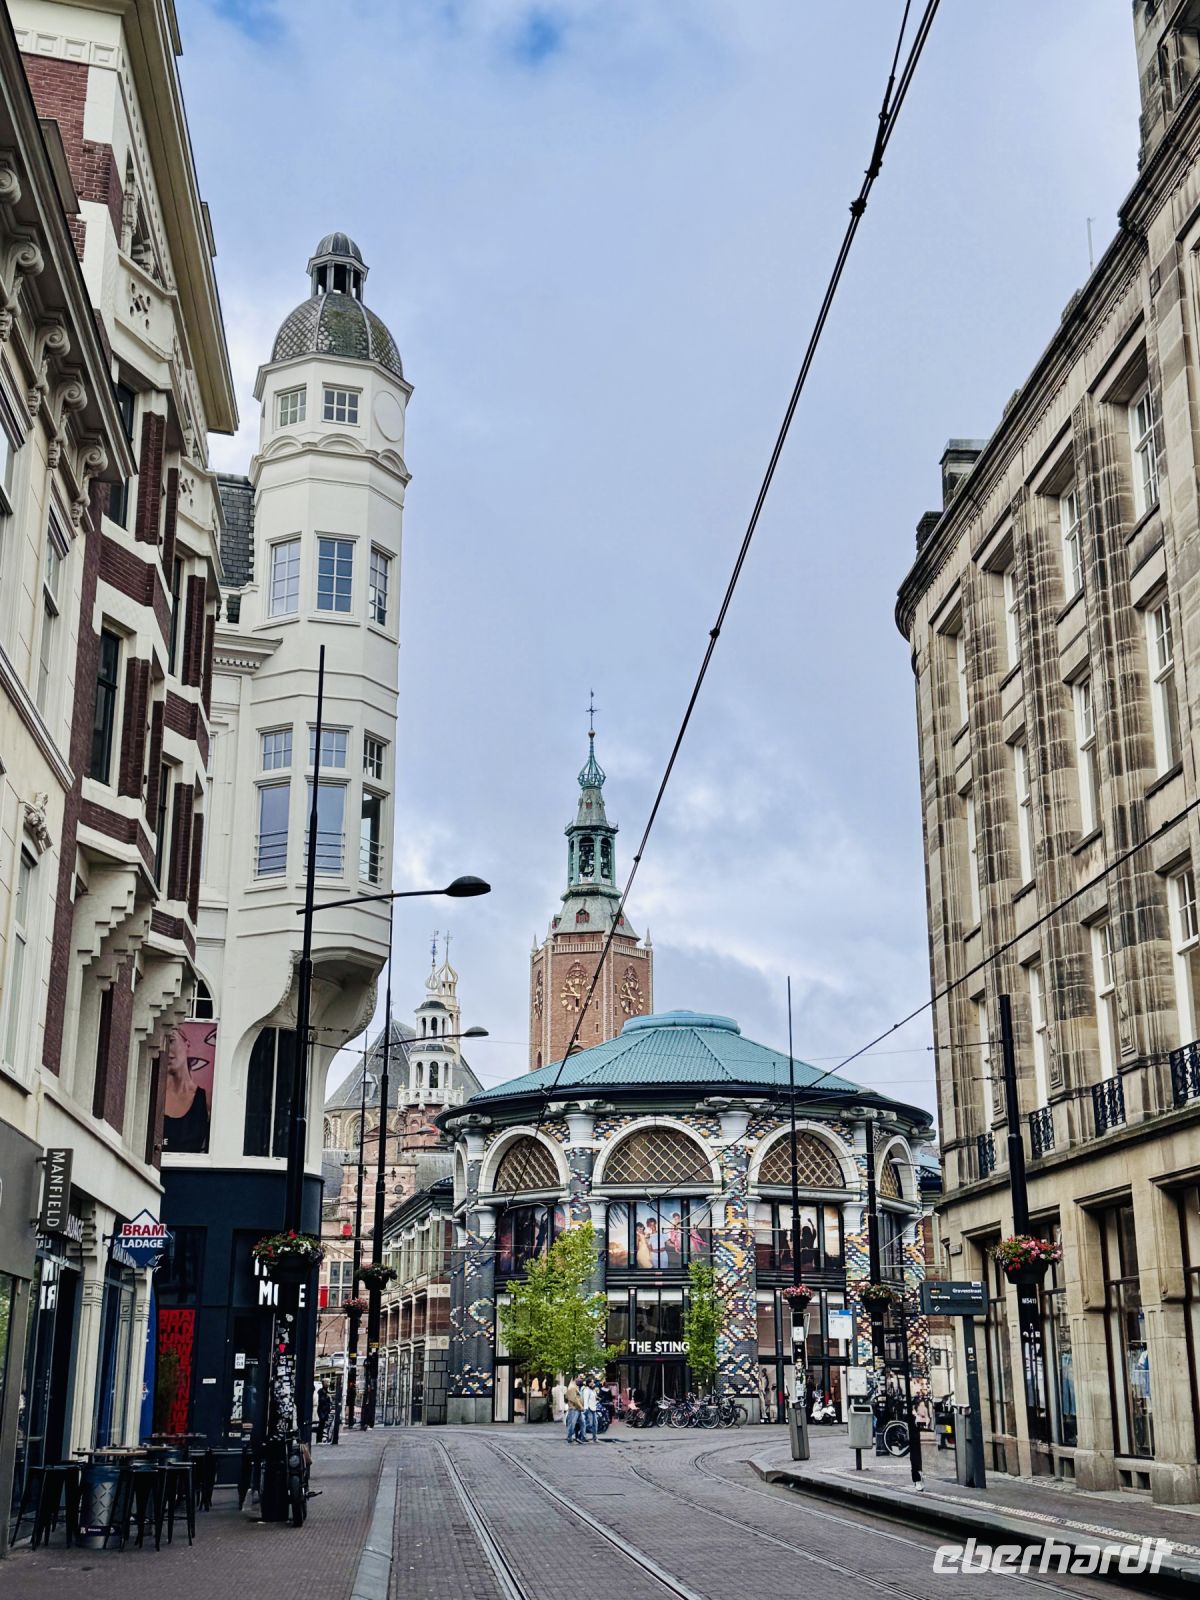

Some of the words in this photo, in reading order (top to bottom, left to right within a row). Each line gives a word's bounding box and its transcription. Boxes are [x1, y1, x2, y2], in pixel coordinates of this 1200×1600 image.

[46, 1151, 66, 1228] MANFIELD
[122, 1224, 166, 1236] BRAM
[121, 1239, 164, 1248] LADAGE
[629, 1341, 652, 1353] THE
[654, 1341, 690, 1353] STING
